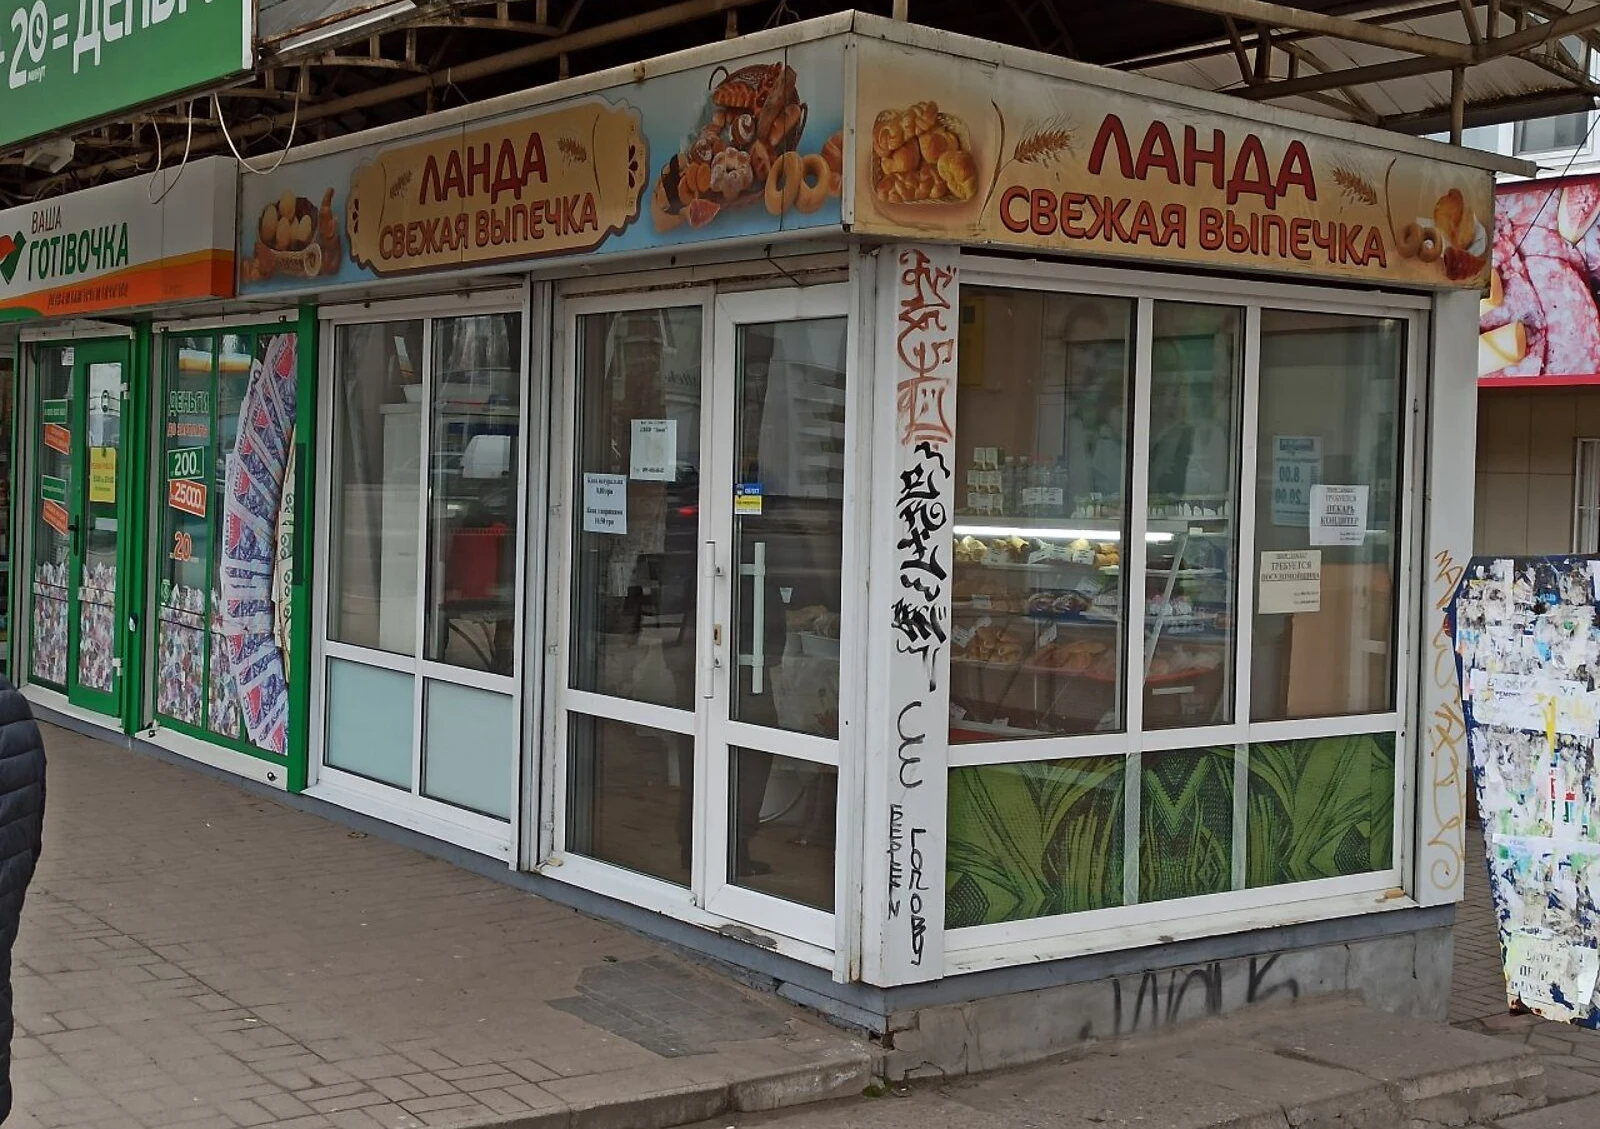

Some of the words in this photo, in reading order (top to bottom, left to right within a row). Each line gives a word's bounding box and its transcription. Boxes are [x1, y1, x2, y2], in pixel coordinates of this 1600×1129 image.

[418, 131, 549, 206] ЛАНДА
[1087, 112, 1318, 211] ЛАНДА
[31, 204, 63, 235] ВАША
[378, 213, 470, 261] СВЕЖАЯ
[475, 191, 599, 248] ВЫПЕЧКА
[999, 185, 1188, 249] СВЕЖАЯ
[1199, 207, 1387, 269] ВЫПЕЧКА
[27, 221, 130, 282] ГОТІВОЧКА
[168, 390, 210, 417] ДЕНЬГИ
[174, 450, 197, 476] 200
[174, 481, 202, 509] 25000
[174, 531, 192, 562] 20
[1271, 560, 1313, 571] ТРЕБУЕТСЯ
